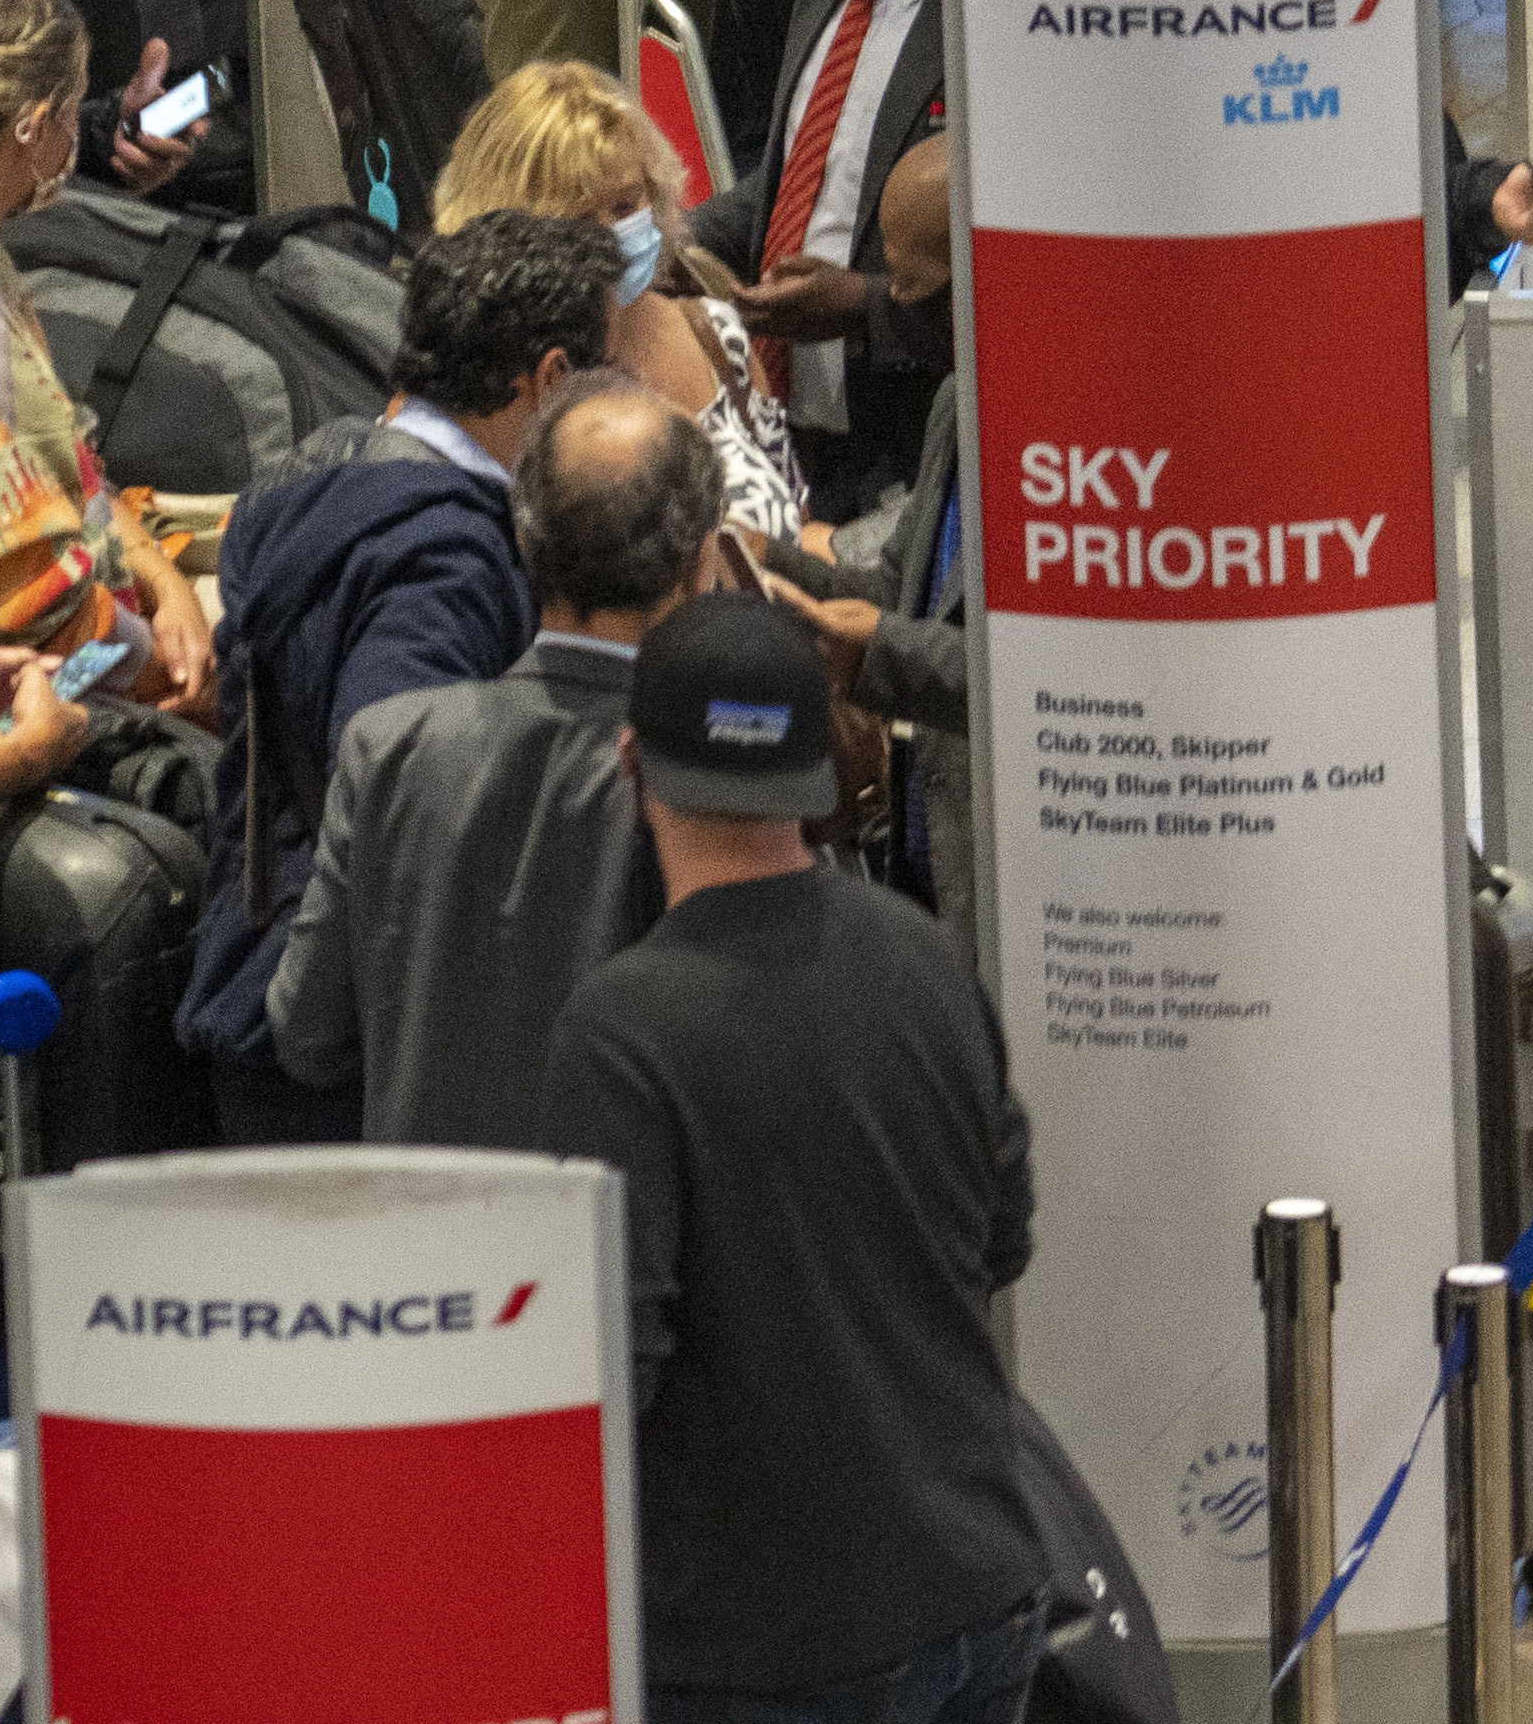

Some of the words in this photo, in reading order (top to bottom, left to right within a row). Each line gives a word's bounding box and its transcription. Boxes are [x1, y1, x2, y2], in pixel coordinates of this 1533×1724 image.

[1222, 86, 1342, 127] KLM
[1020, 441, 1172, 511] SKY
[1023, 513, 1387, 591] PRIORITY
[1035, 690, 1145, 719] Business
[1036, 728, 1092, 756] Club
[1097, 733, 1163, 760] 2000,
[1170, 735, 1271, 762] Skipper
[1038, 766, 1108, 799] Flying
[1115, 772, 1172, 797] Blue
[1179, 772, 1294, 798] Platinum
[1301, 770, 1319, 791] &
[1326, 762, 1386, 791] Gold
[1039, 805, 1148, 836] SkyTeam
[1155, 812, 1212, 837] Elite
[1219, 812, 1276, 836] Plus
[1042, 902, 1074, 924] We
[1079, 906, 1120, 926] also
[1043, 931, 1132, 956] Premium
[1044, 960, 1103, 990] Flying
[1108, 965, 1155, 988] Blue
[1161, 967, 1220, 989] Silver
[1045, 990, 1105, 1019] Flying
[1109, 995, 1156, 1018] Blue
[1161, 996, 1272, 1019] Petroleum
[1046, 1021, 1137, 1049] SkyTeam
[1143, 1027, 1189, 1050] Elite
[84, 1290, 476, 1341] AIRFRANCE
